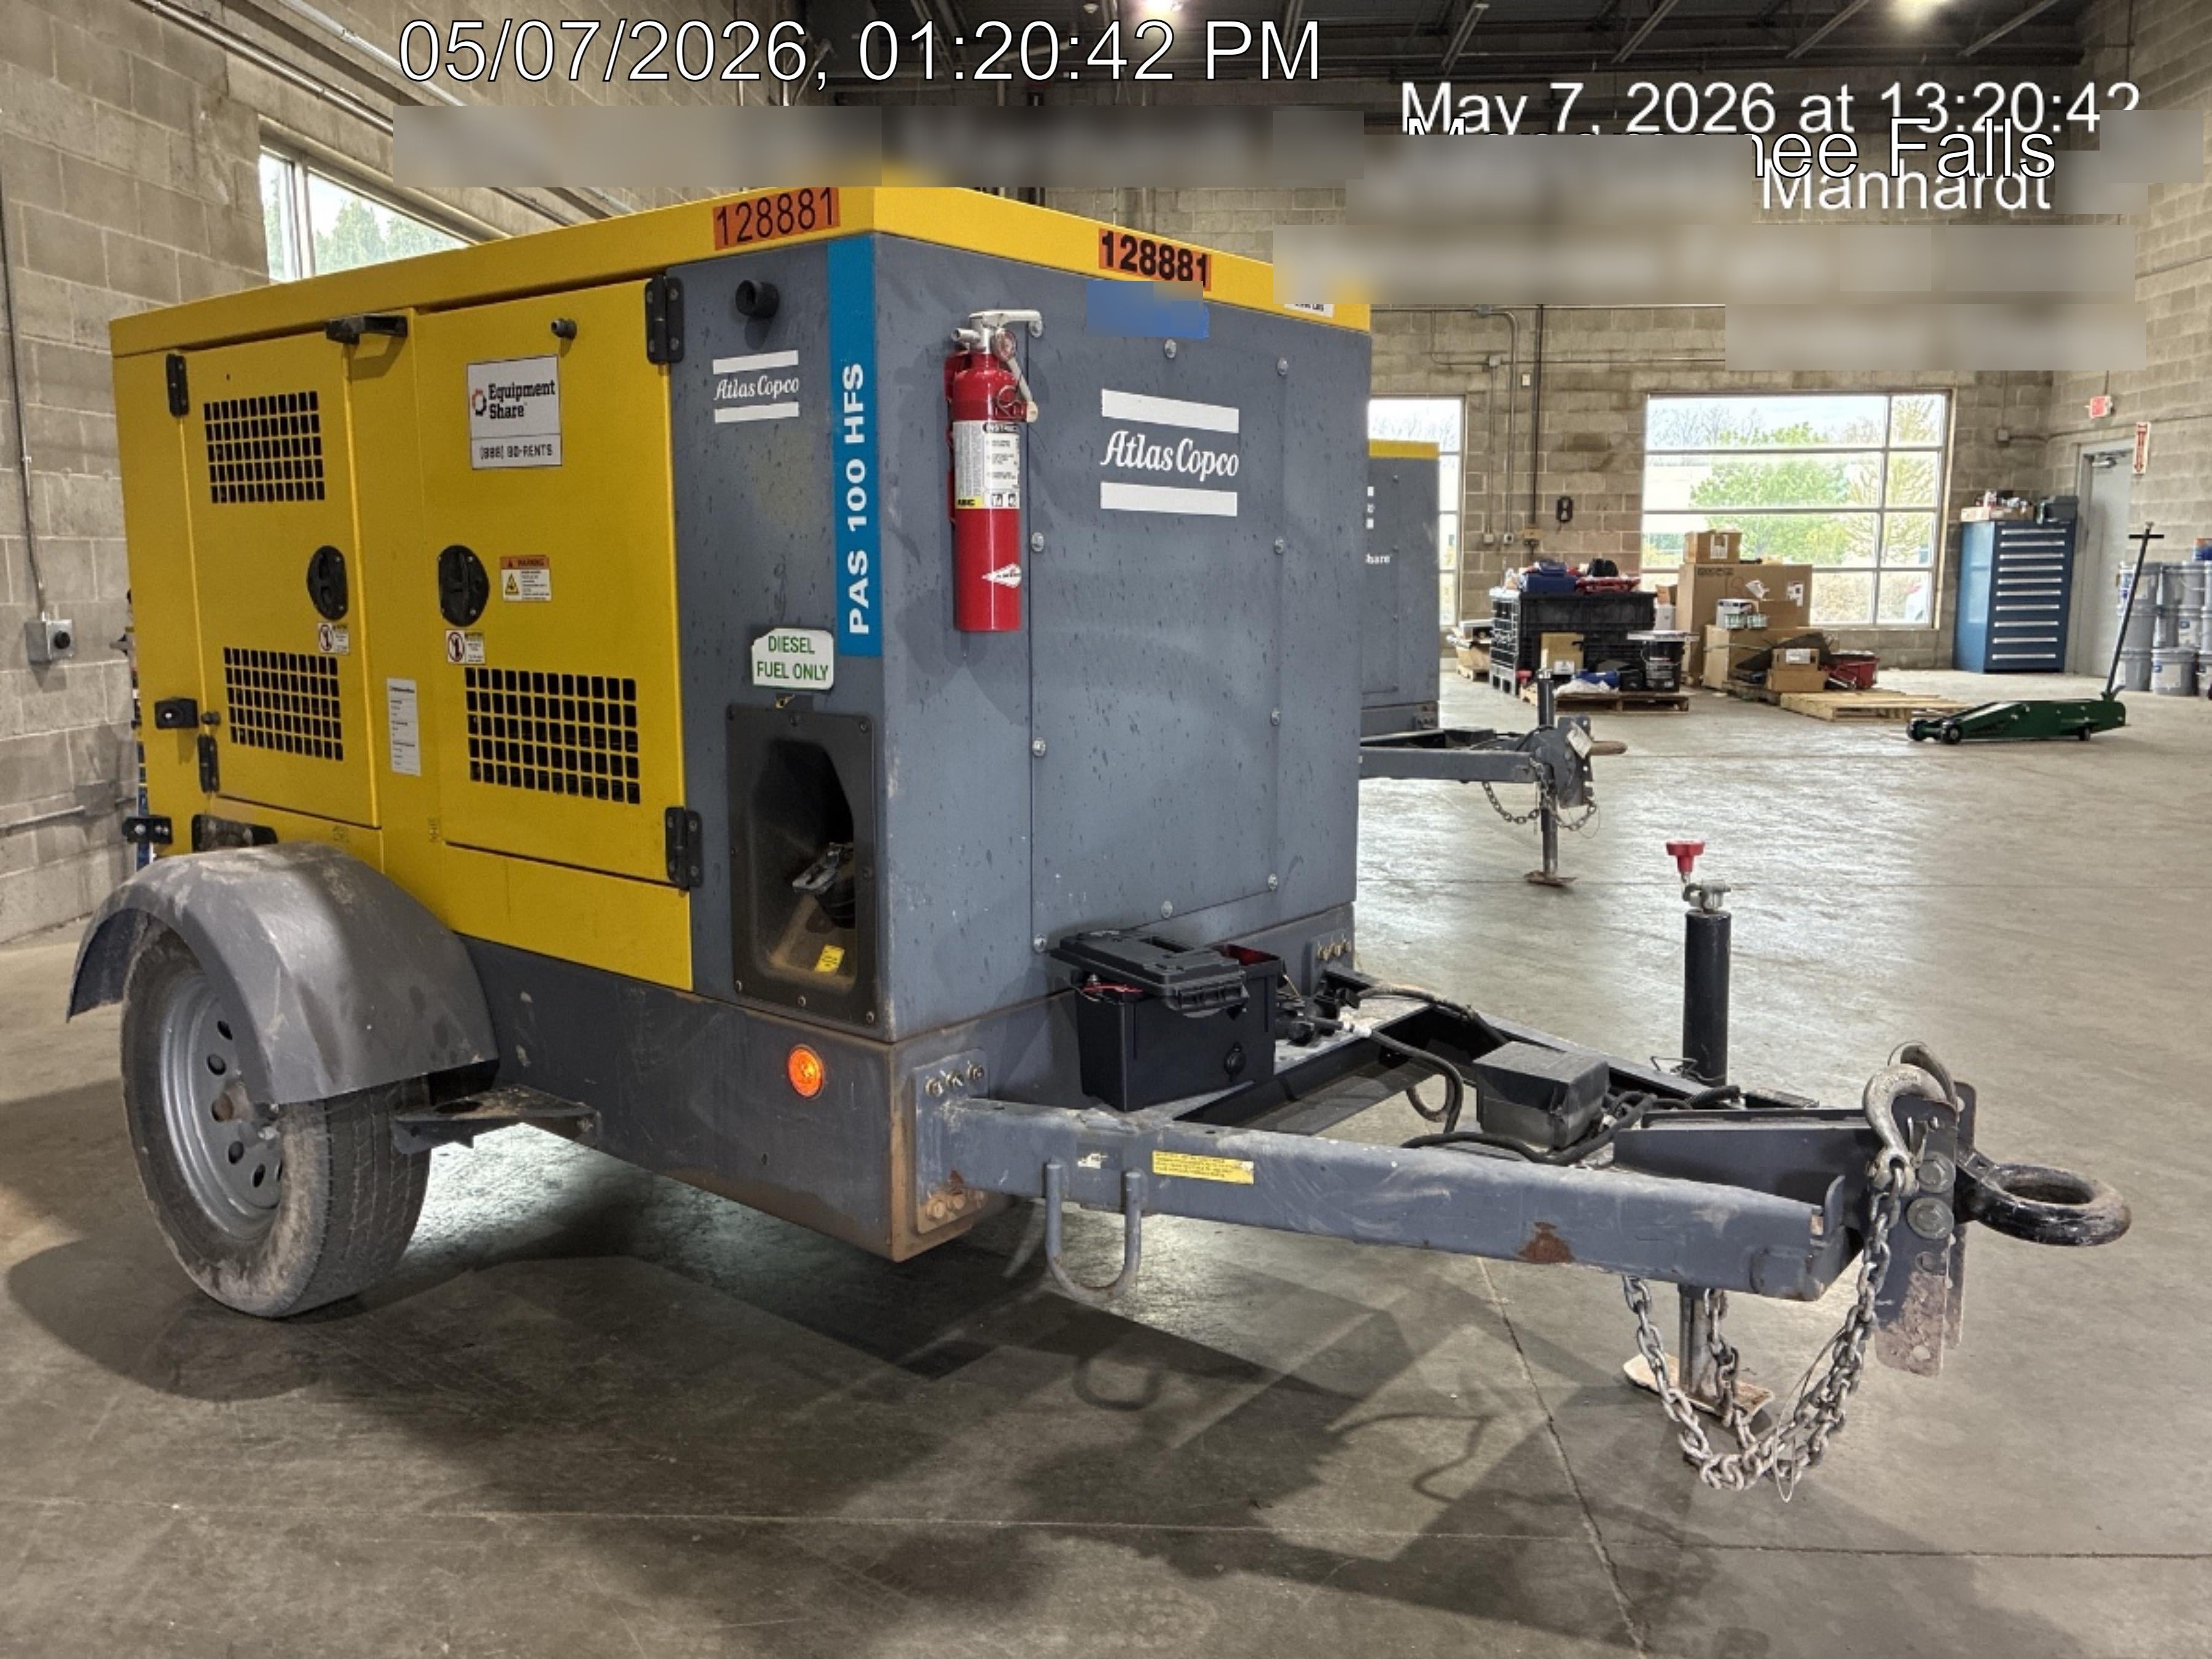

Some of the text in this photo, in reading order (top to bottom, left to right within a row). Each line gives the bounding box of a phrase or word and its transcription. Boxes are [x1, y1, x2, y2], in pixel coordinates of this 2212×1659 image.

[716, 187, 833, 246] 128881
[1102, 230, 1206, 288] 128881
[488, 379, 555, 402] Equipment
[490, 404, 524, 419] Share
[842, 363, 869, 635] PAS 100 HFS
[768, 635, 815, 654] DIESEL
[757, 661, 829, 681] FUEL ONLY
